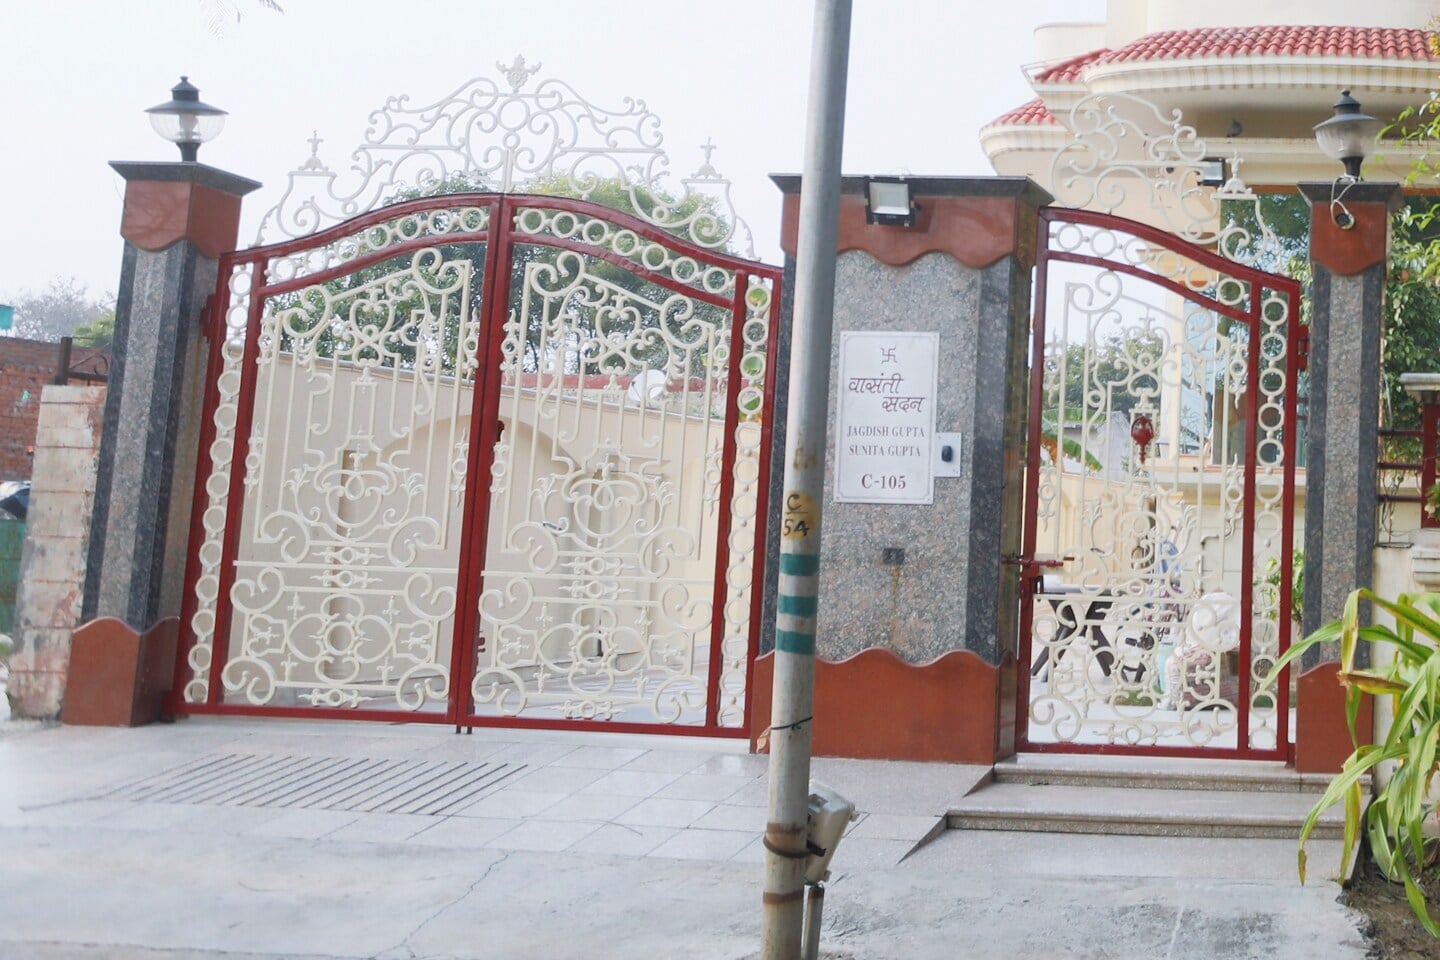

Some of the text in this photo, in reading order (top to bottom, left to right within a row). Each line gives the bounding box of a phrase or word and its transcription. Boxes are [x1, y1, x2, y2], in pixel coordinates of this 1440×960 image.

[848, 372, 904, 394] वासंती
[882, 396, 926, 413] सदन
[847, 425, 925, 438] JAGDISH GUPTA
[849, 444, 921, 457] SUNITA GUPTA
[861, 473, 906, 490] C-105
[787, 493, 802, 512] C
[783, 518, 810, 537] 54
